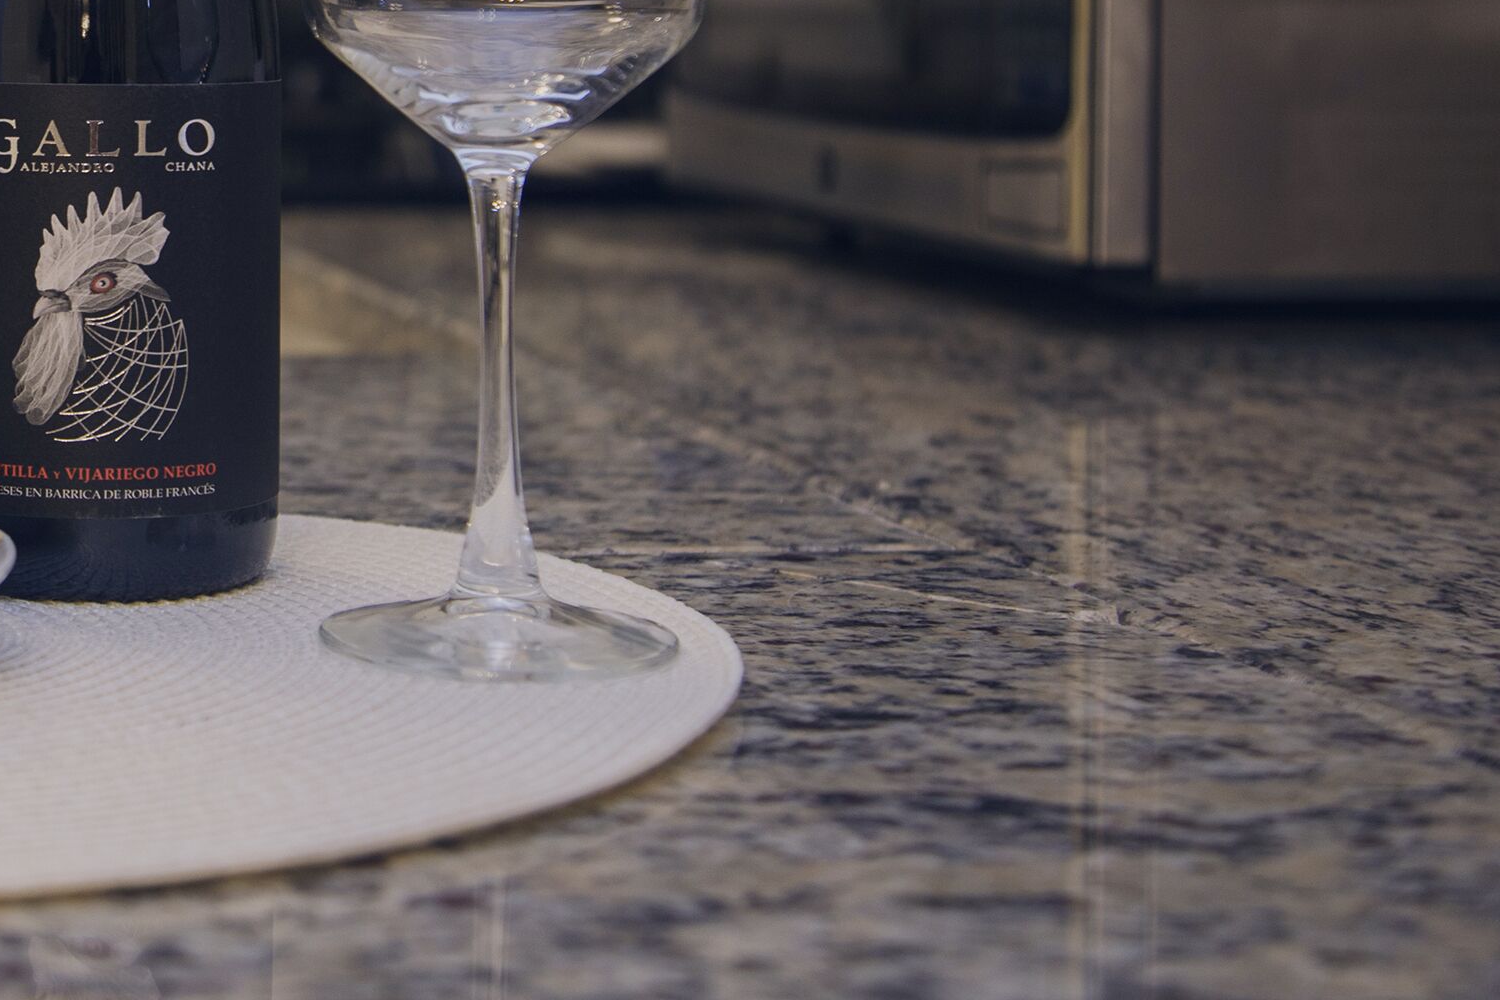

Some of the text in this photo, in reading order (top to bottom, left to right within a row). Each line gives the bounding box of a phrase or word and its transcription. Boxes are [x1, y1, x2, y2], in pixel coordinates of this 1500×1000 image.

[19, 161, 216, 174] ALEJANDRO CHANA
[65, 467, 159, 483] VIJARIEGO
[163, 462, 217, 478] NEGRO
[25, 487, 43, 498] EN
[46, 489, 101, 500] BARRICA
[104, 490, 122, 500] DE
[124, 488, 163, 499] ROBLE
[166, 482, 216, 497] FRANCÉS
